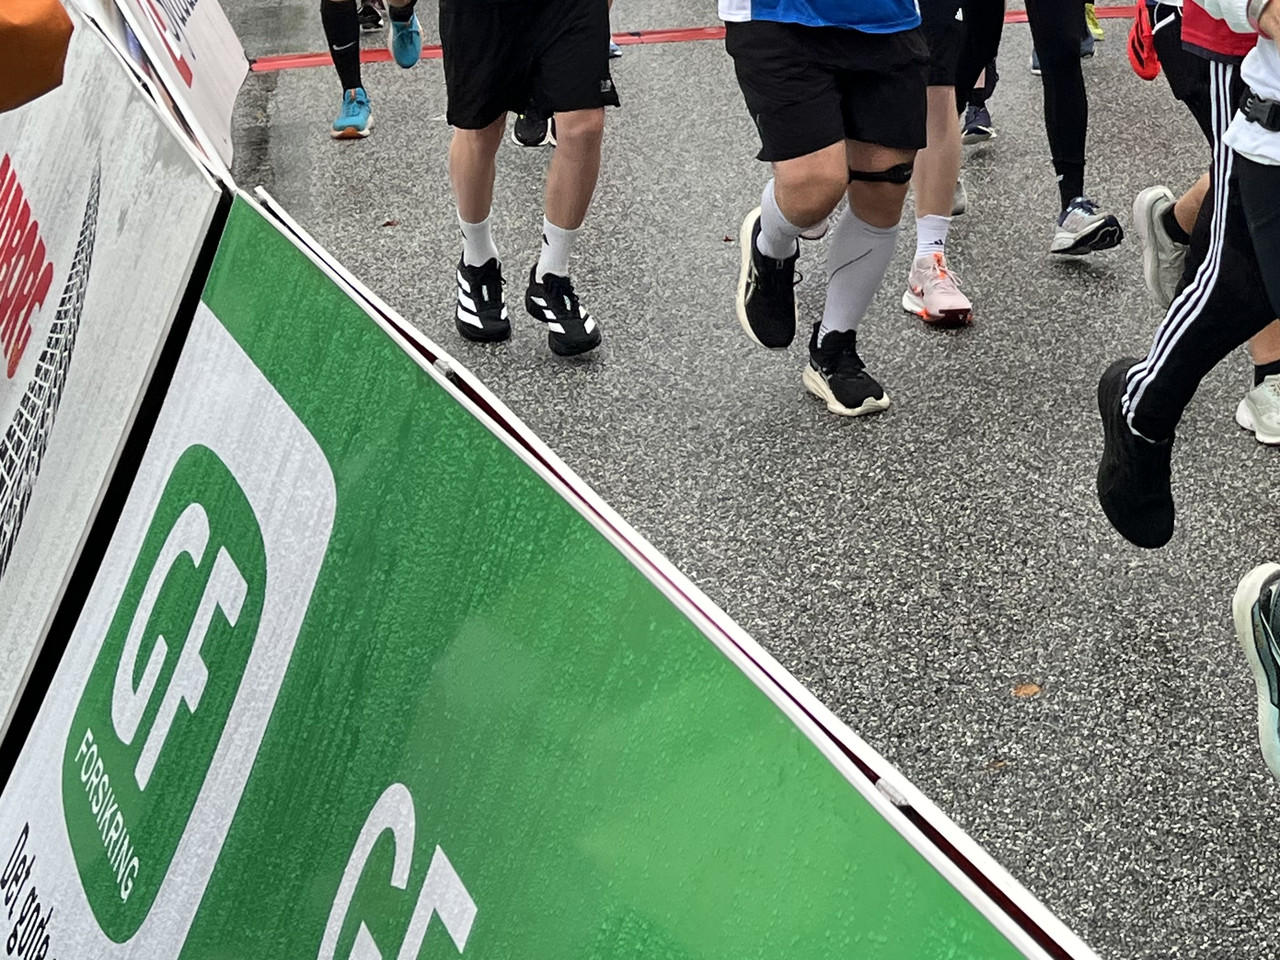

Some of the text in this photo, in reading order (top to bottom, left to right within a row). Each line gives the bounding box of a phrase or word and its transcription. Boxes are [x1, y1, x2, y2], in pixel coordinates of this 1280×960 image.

[111, 502, 248, 791] GF
[0, 822, 36, 920] Det
[75, 728, 140, 904] FORSIKRING
